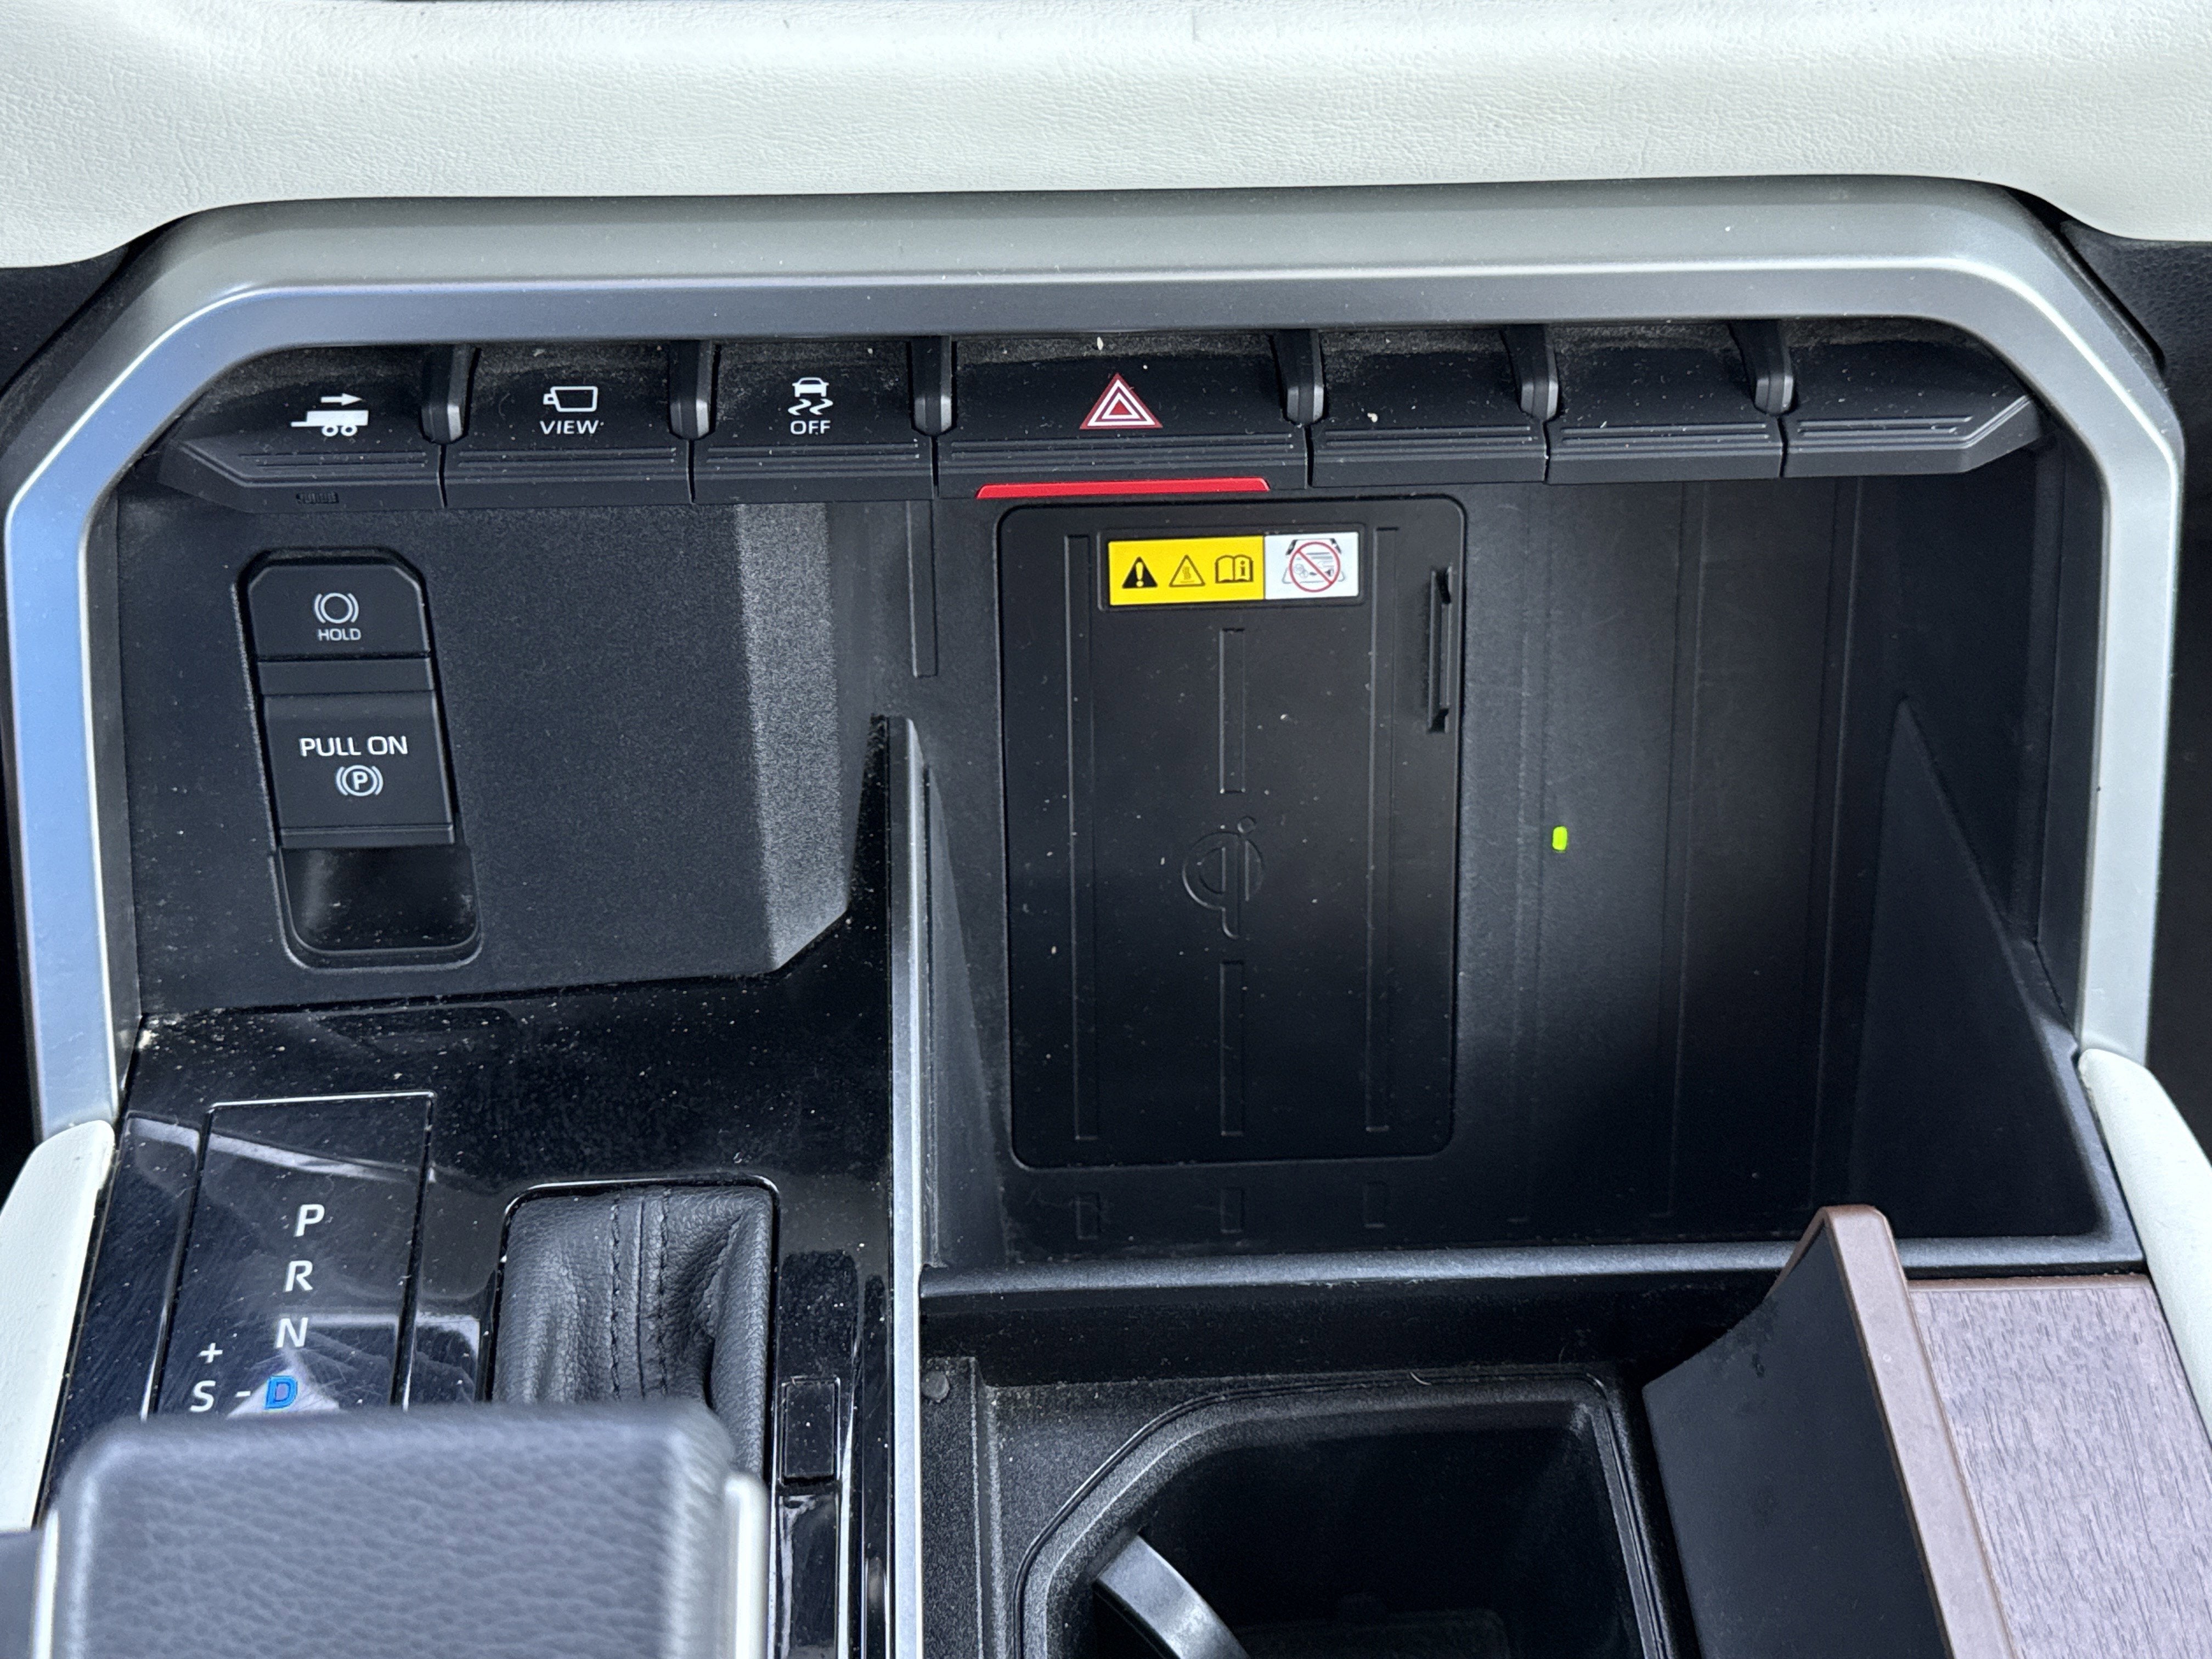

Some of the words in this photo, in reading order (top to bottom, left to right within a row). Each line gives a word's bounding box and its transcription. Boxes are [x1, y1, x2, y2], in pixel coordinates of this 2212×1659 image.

[539, 419, 600, 435] VIEW
[789, 419, 831, 436] OFF
[317, 627, 362, 642] HOLD
[299, 736, 362, 758] PULL
[366, 735, 409, 756] ON
[294, 1203, 325, 1238] P
[284, 1260, 314, 1293] R
[275, 1317, 309, 1349] N
[189, 1380, 217, 1413] S
[263, 1375, 299, 1410] D
